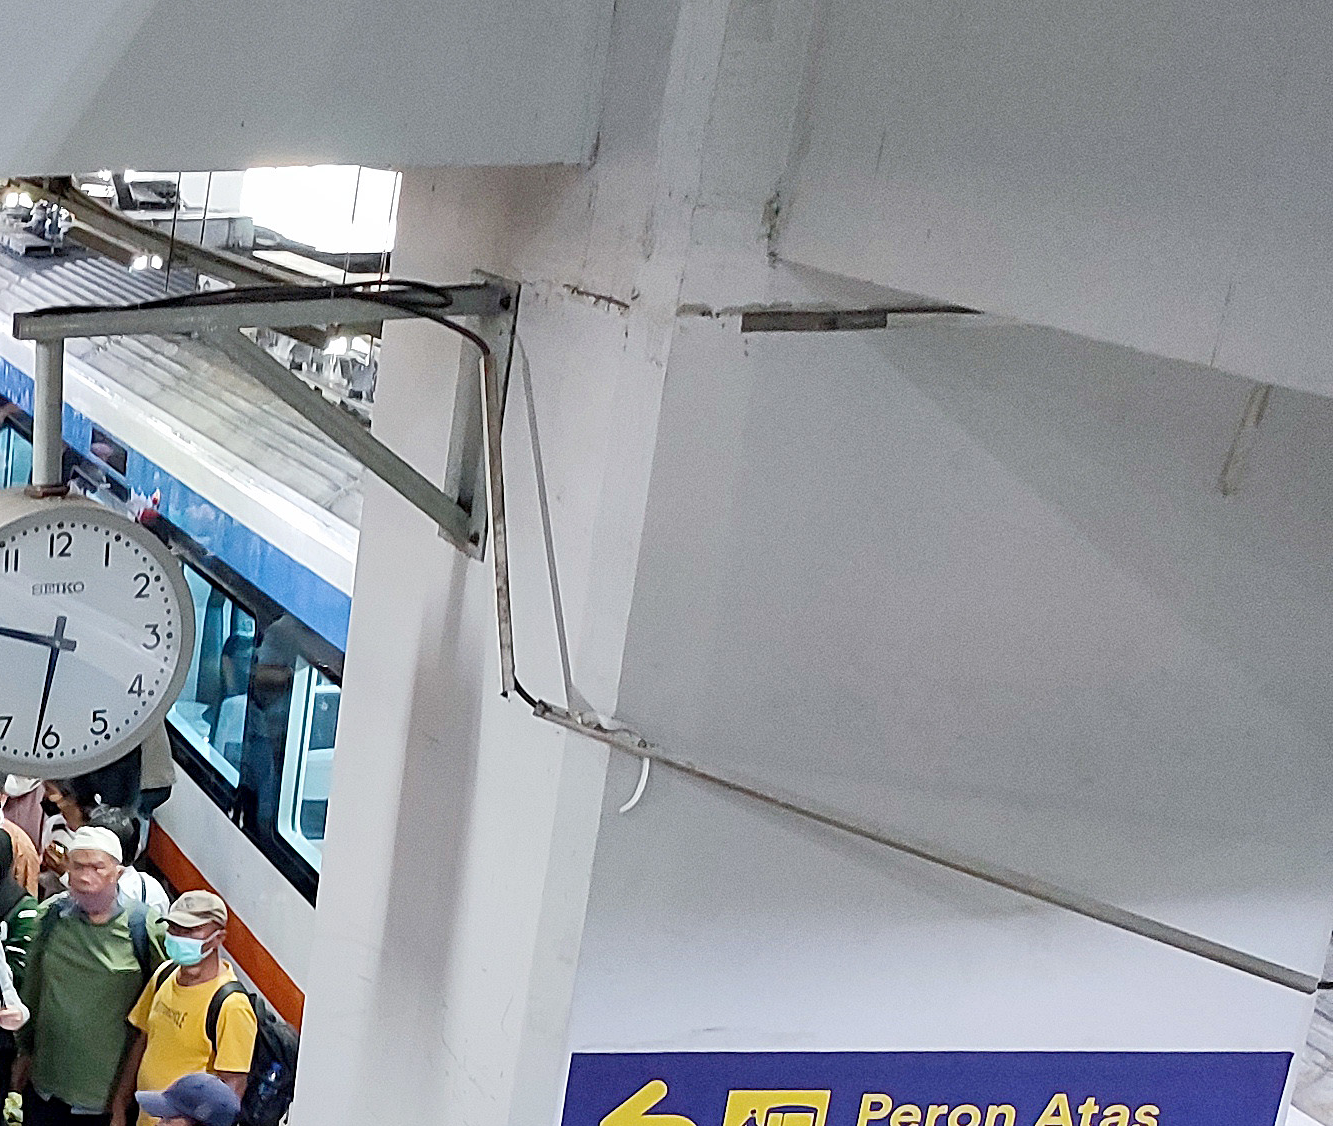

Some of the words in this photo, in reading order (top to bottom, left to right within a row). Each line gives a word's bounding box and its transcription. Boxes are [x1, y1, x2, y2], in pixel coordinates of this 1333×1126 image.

[49, 531, 73, 559] 12
[104, 541, 110, 568] 1
[4, 548, 19, 573] 11
[32, 581, 85, 596] SEIKO
[133, 572, 150, 599] 2
[142, 623, 161, 650] 3
[127, 674, 146, 697] 4
[90, 709, 108, 735] 5
[40, 723, 61, 750] 6
